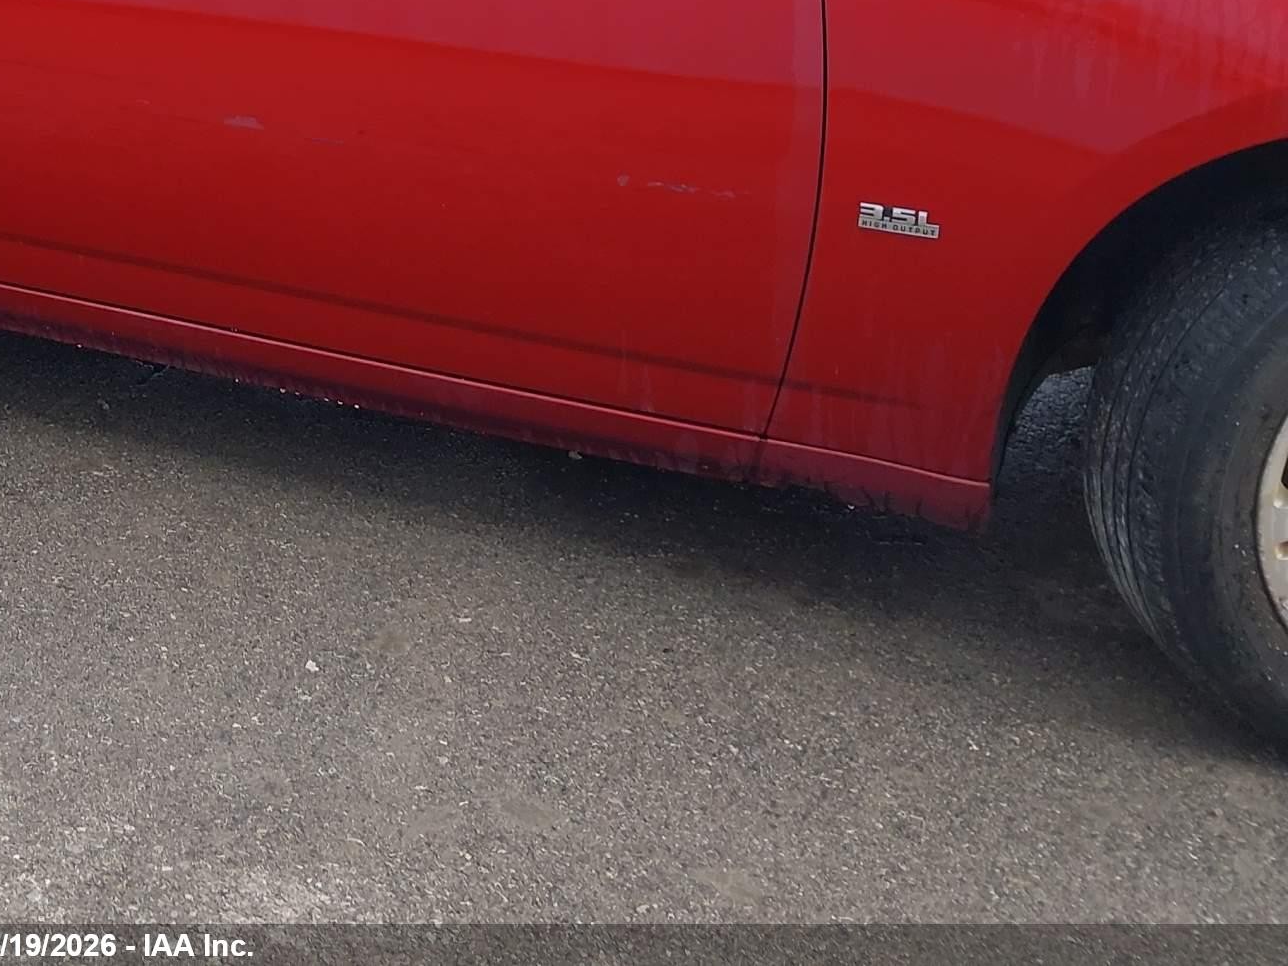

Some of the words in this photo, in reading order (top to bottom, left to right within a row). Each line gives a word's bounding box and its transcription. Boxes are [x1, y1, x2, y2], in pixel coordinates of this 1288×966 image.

[860, 202, 937, 227] 3.5L
[861, 219, 888, 229] HIGH
[892, 224, 936, 236] OUTPUT
